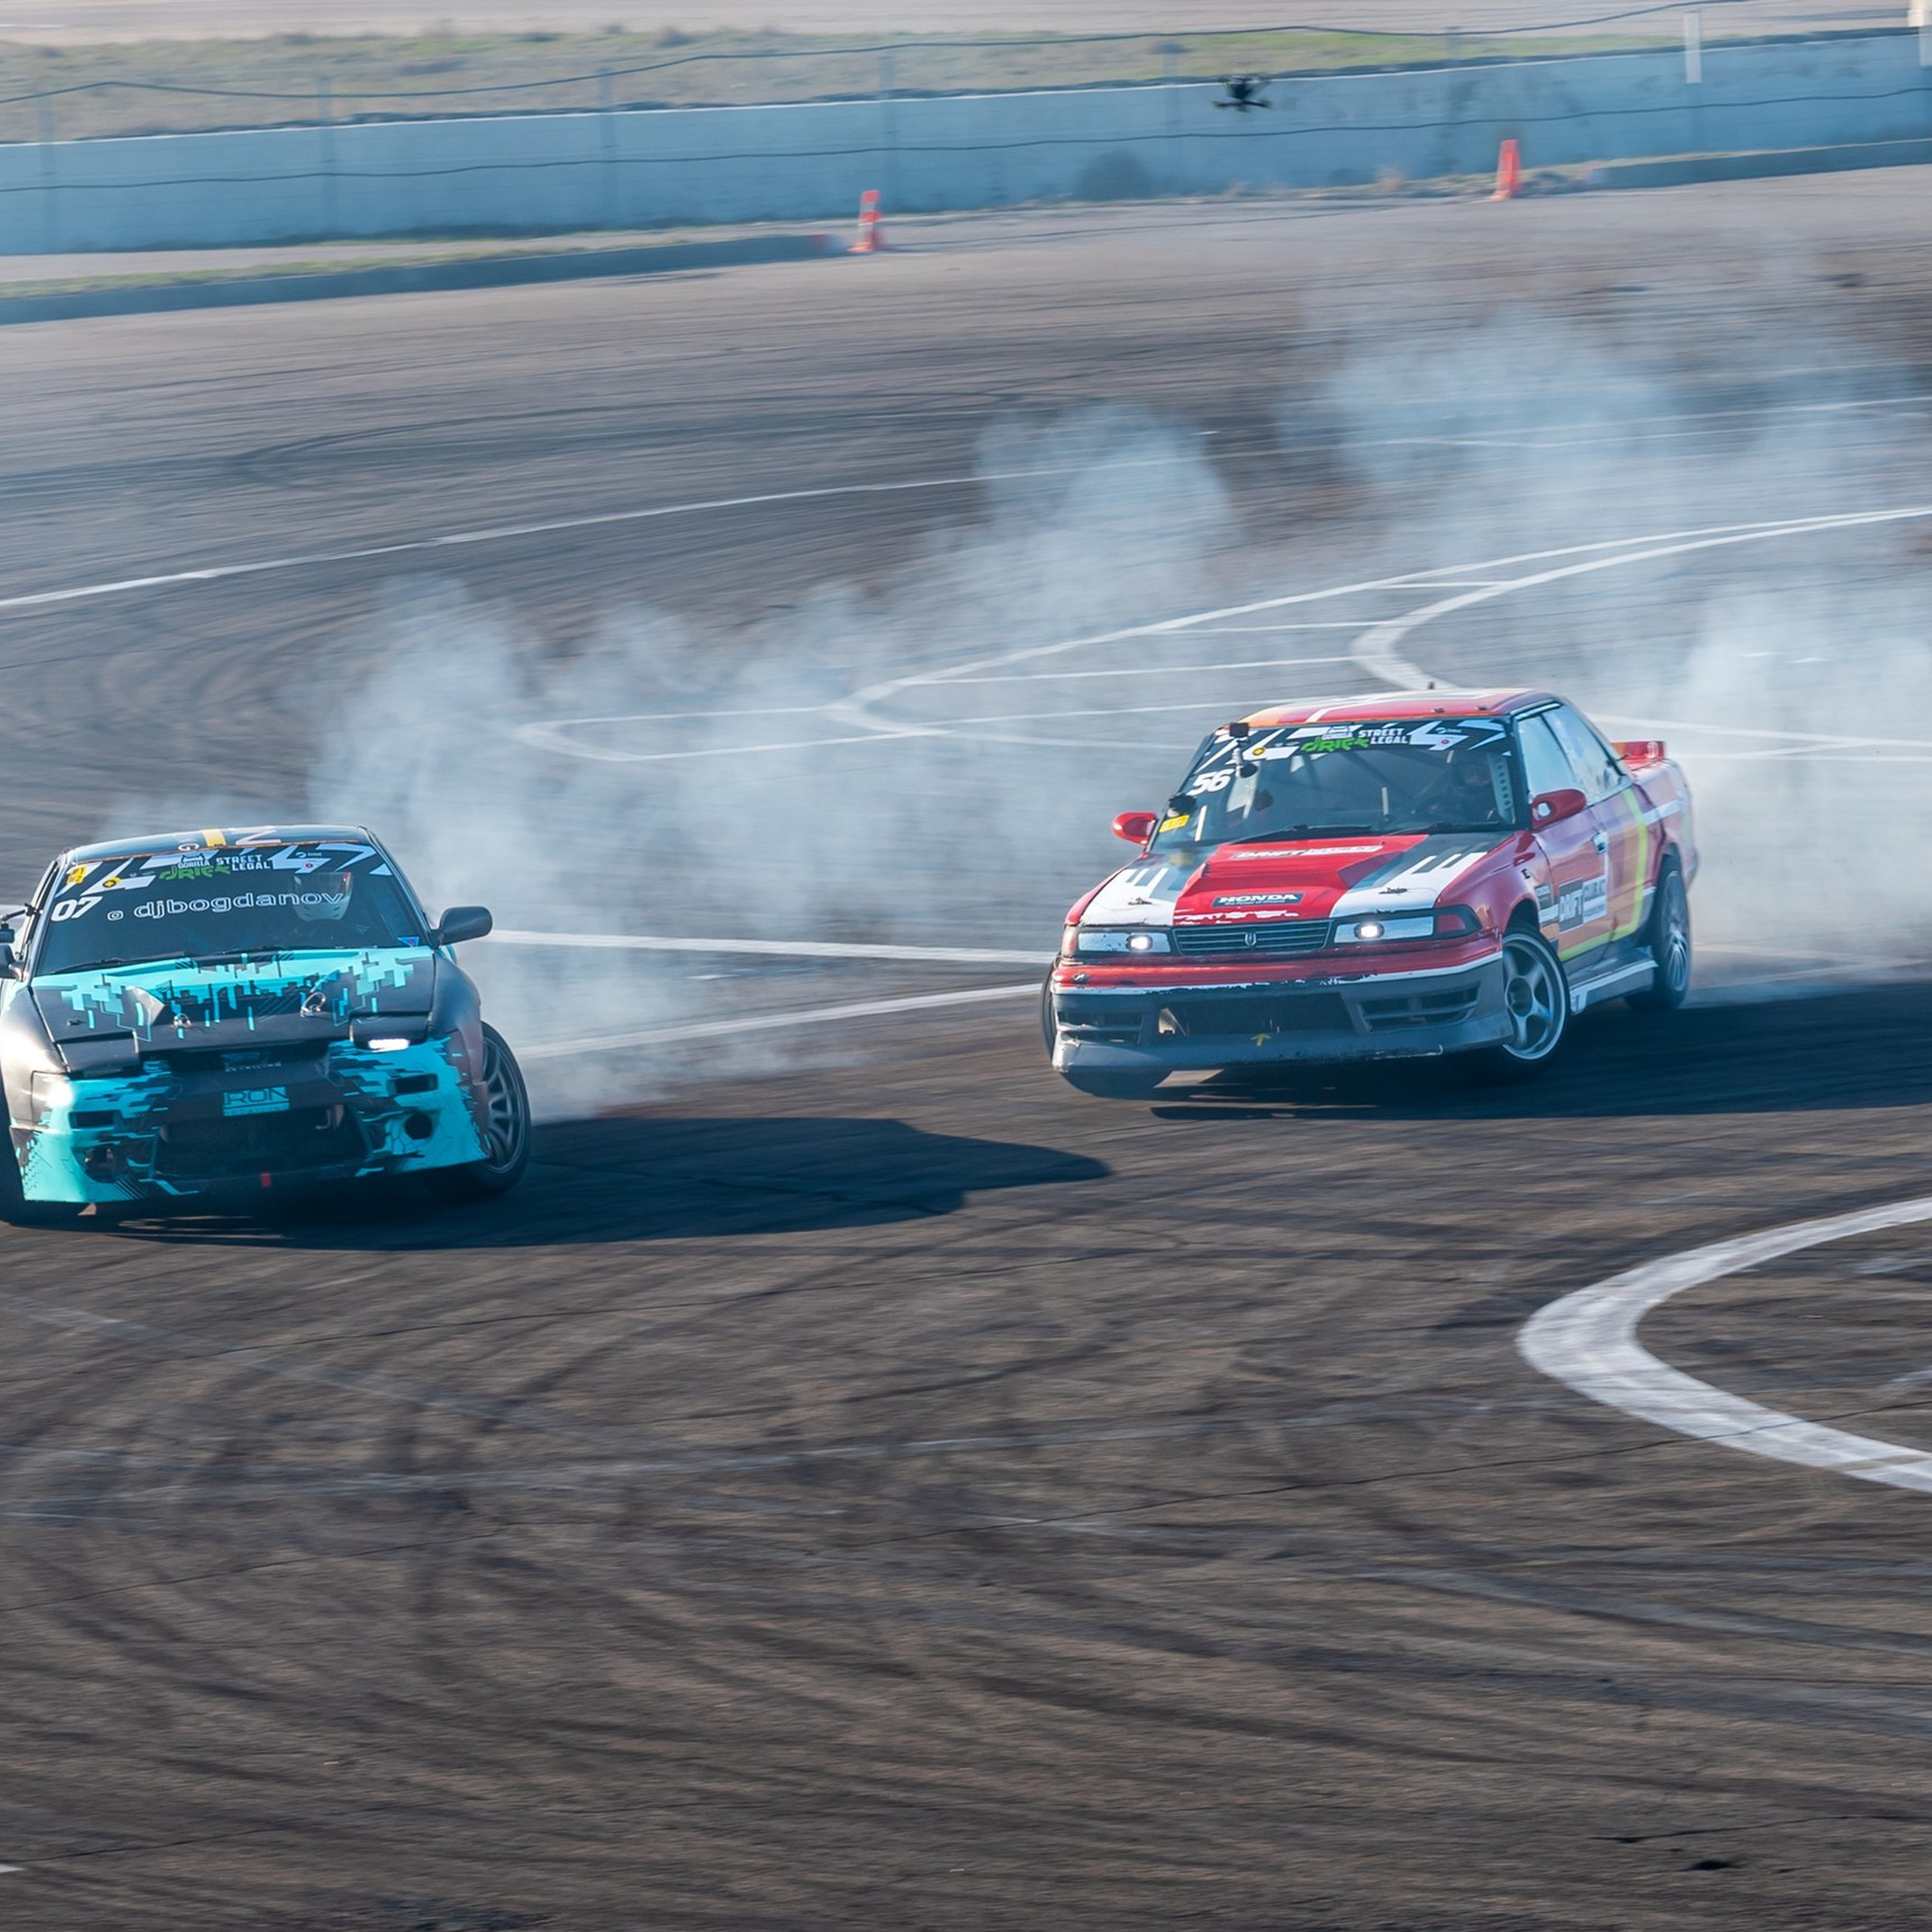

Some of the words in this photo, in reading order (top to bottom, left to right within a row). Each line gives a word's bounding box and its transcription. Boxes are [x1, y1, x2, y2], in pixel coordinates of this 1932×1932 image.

[1358, 728, 1404, 738] STREET
[1370, 736, 1408, 745] LEGAL
[1186, 769, 1235, 796] 56
[177, 860, 211, 869] GORILLA
[216, 854, 262, 866] STREET
[232, 861, 271, 872] LEGAL
[1218, 894, 1298, 903] HONDA
[51, 896, 103, 921] 07
[134, 892, 344, 919] djbogdanov
